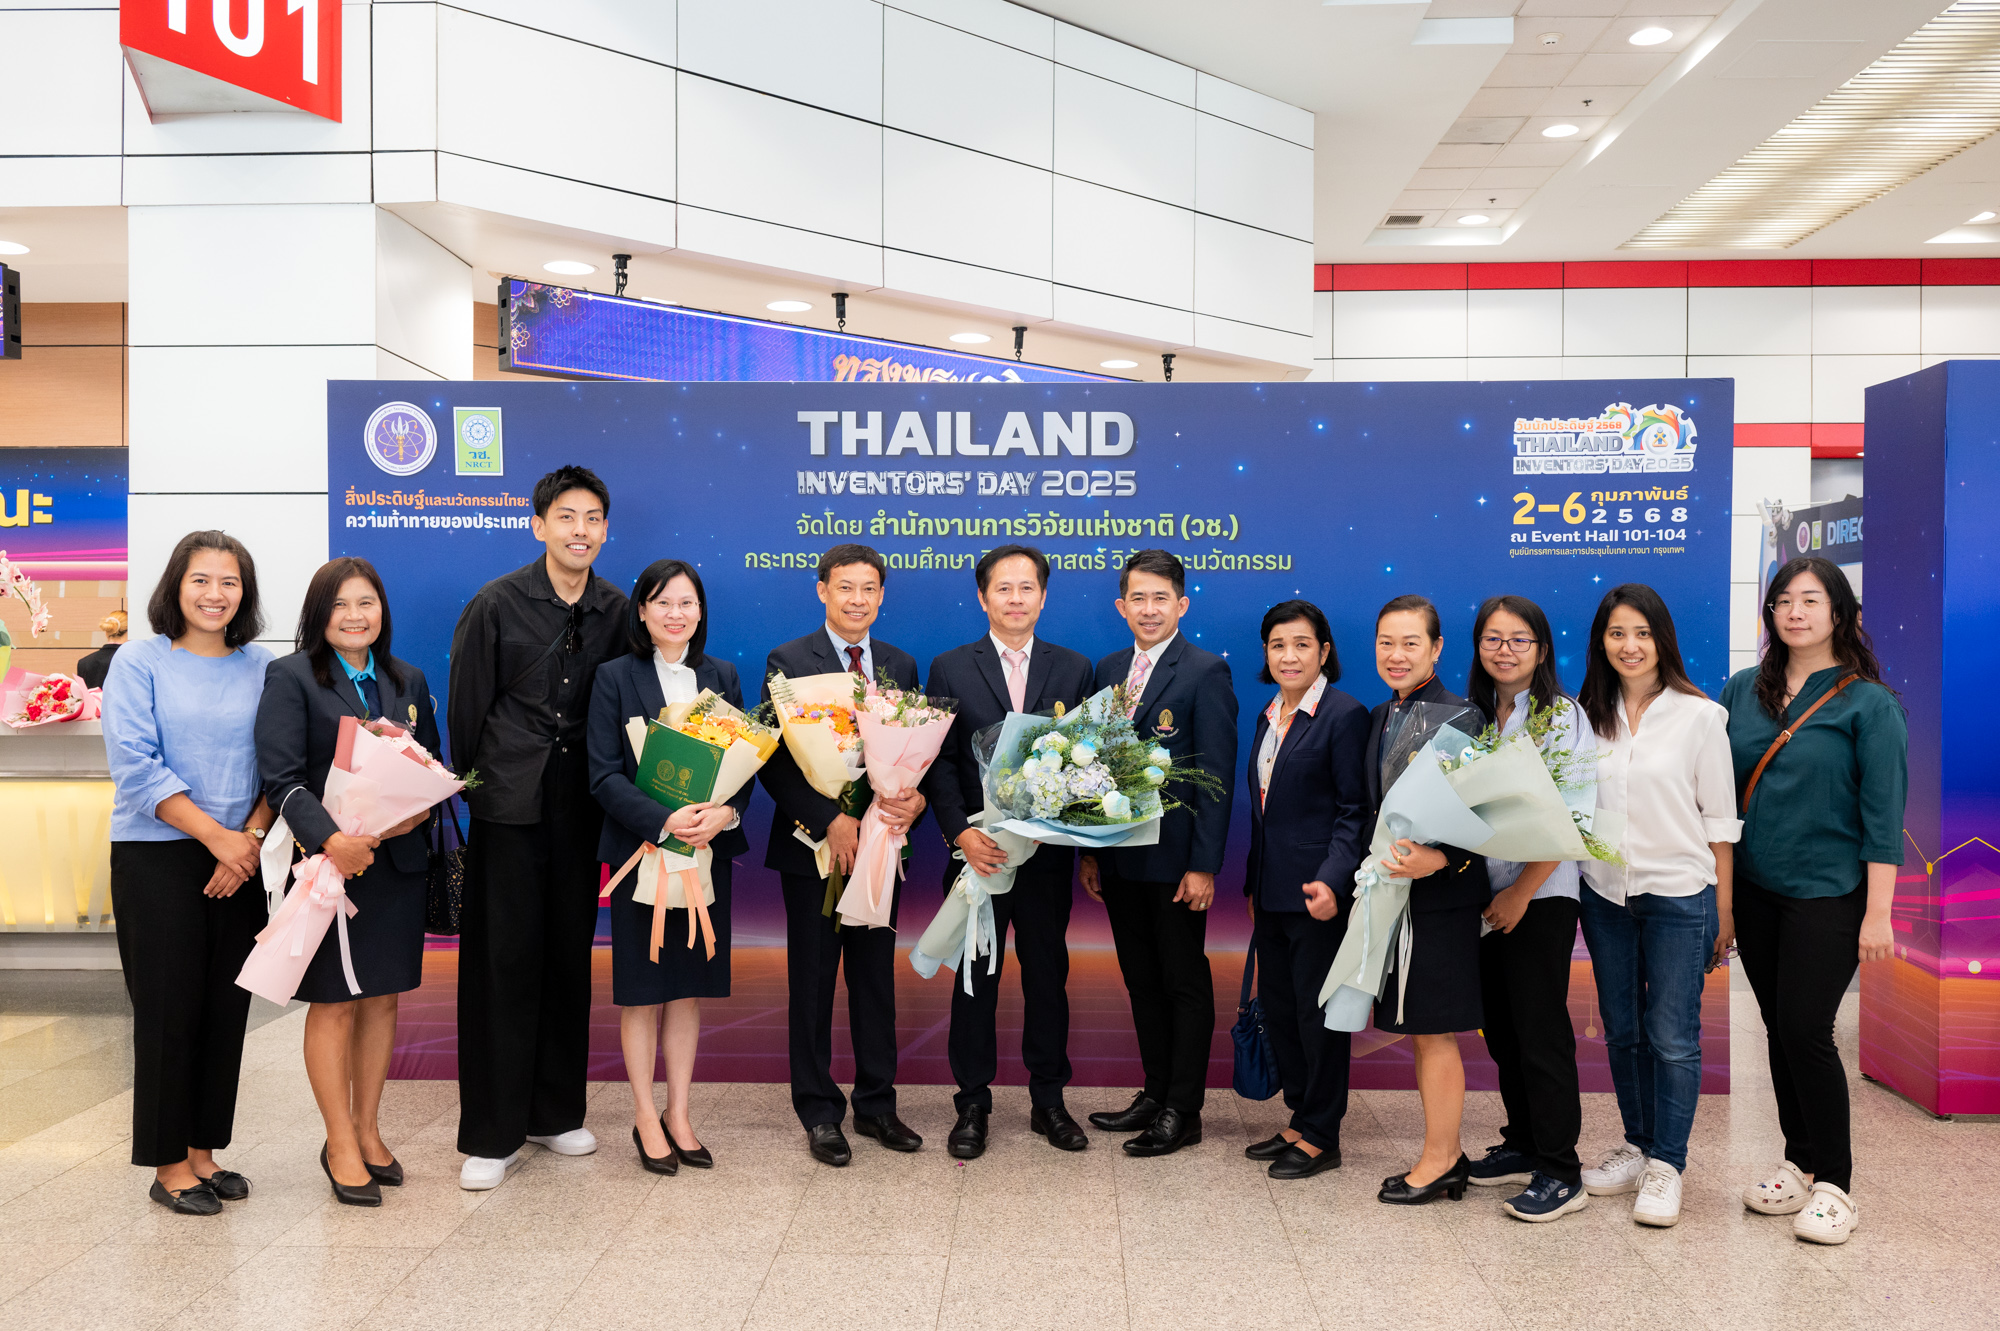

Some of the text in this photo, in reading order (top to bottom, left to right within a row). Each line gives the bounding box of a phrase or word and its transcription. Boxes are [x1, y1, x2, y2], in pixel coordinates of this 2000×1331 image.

[797, 411, 1134, 456] THAILAND
[1516, 419, 1622, 432] วันนักประดิษฐ์ 2568
[1517, 436, 1623, 452] THAILAND
[1516, 458, 1692, 472] INVENTORS' DAY 2025
[797, 470, 1137, 496] INVENTORS' DAY 2025
[1513, 485, 1689, 525] 2-6 กุมภาพันธ์
[345, 509, 530, 529] ความท้าทายของประเทศ
[796, 509, 1239, 540] จัดโดย สำนักงานการวิจัยแห่งชาติ (วช.)
[1510, 529, 1687, 543] ณ Event Hall 101-104
